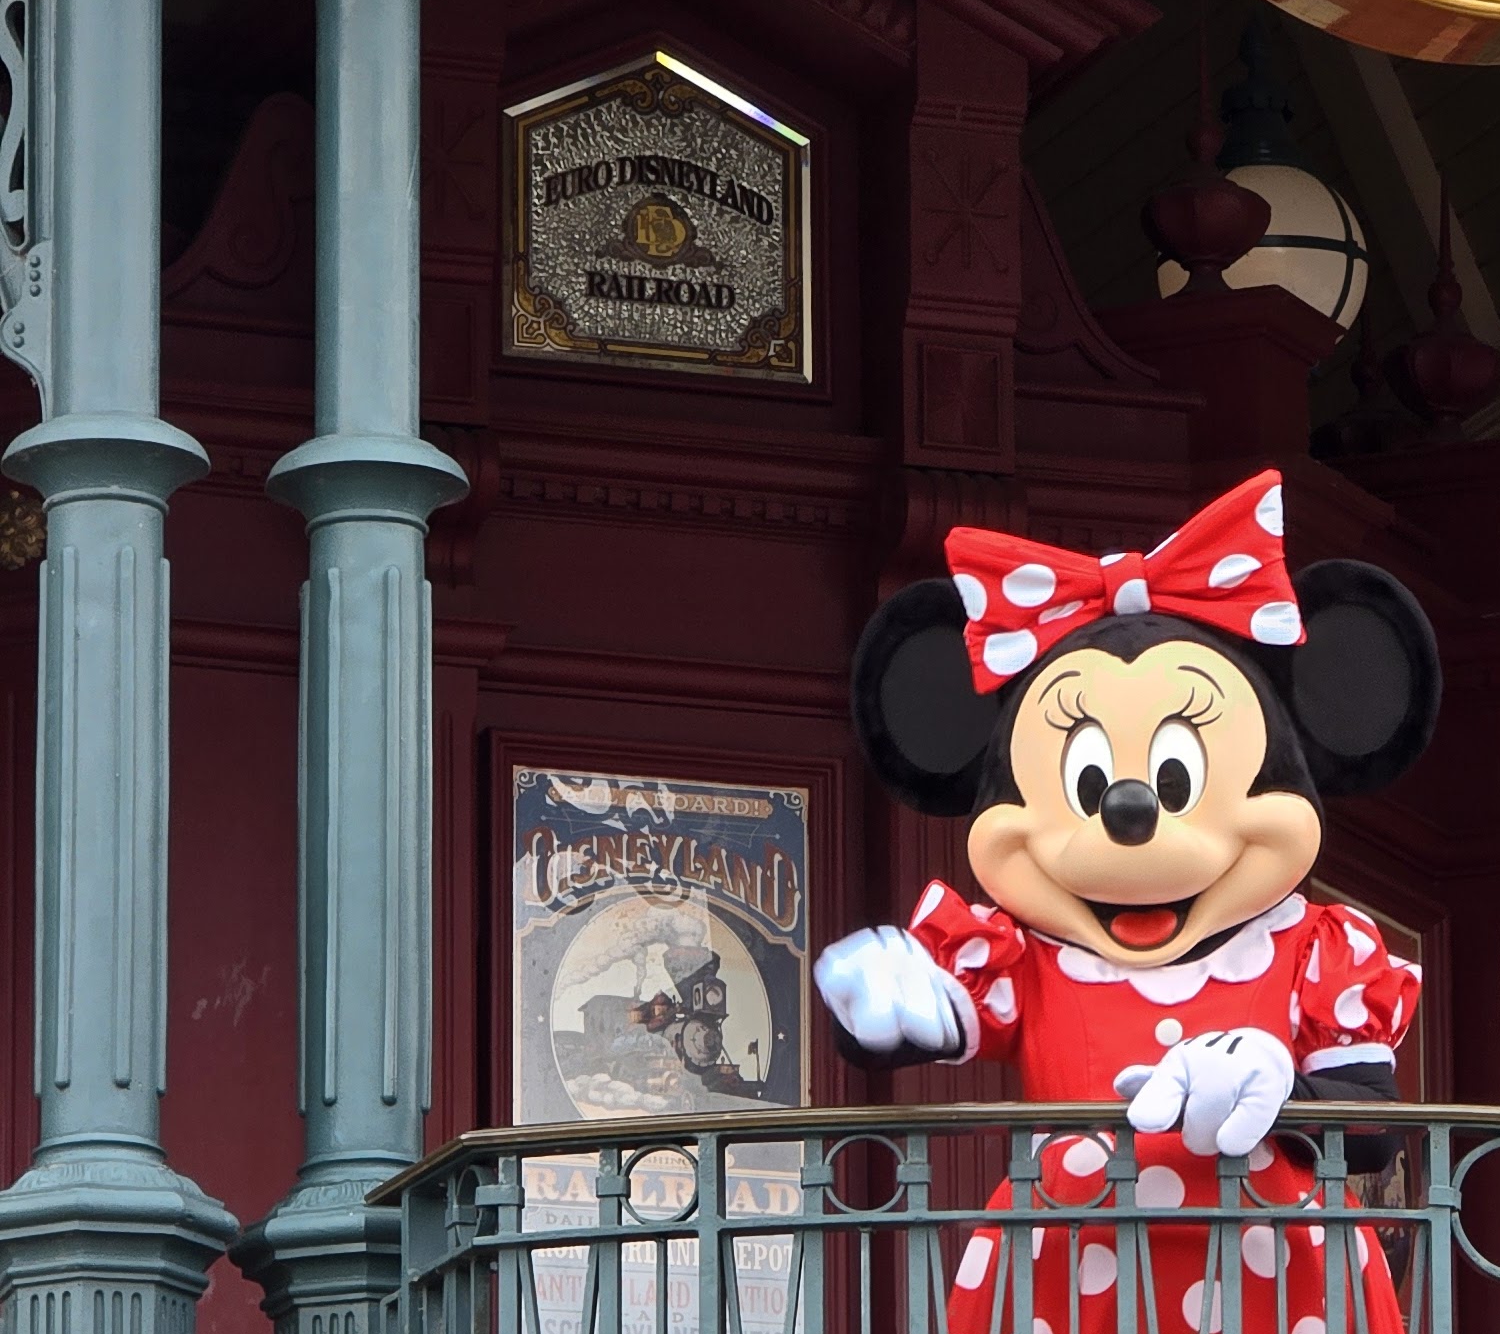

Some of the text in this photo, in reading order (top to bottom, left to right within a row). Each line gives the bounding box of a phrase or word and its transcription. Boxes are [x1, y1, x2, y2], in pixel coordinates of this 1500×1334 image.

[543, 153, 774, 227] EURO DISNEYLAND
[585, 270, 737, 311] RAILROAD
[522, 825, 802, 933] DISNEYLAND
